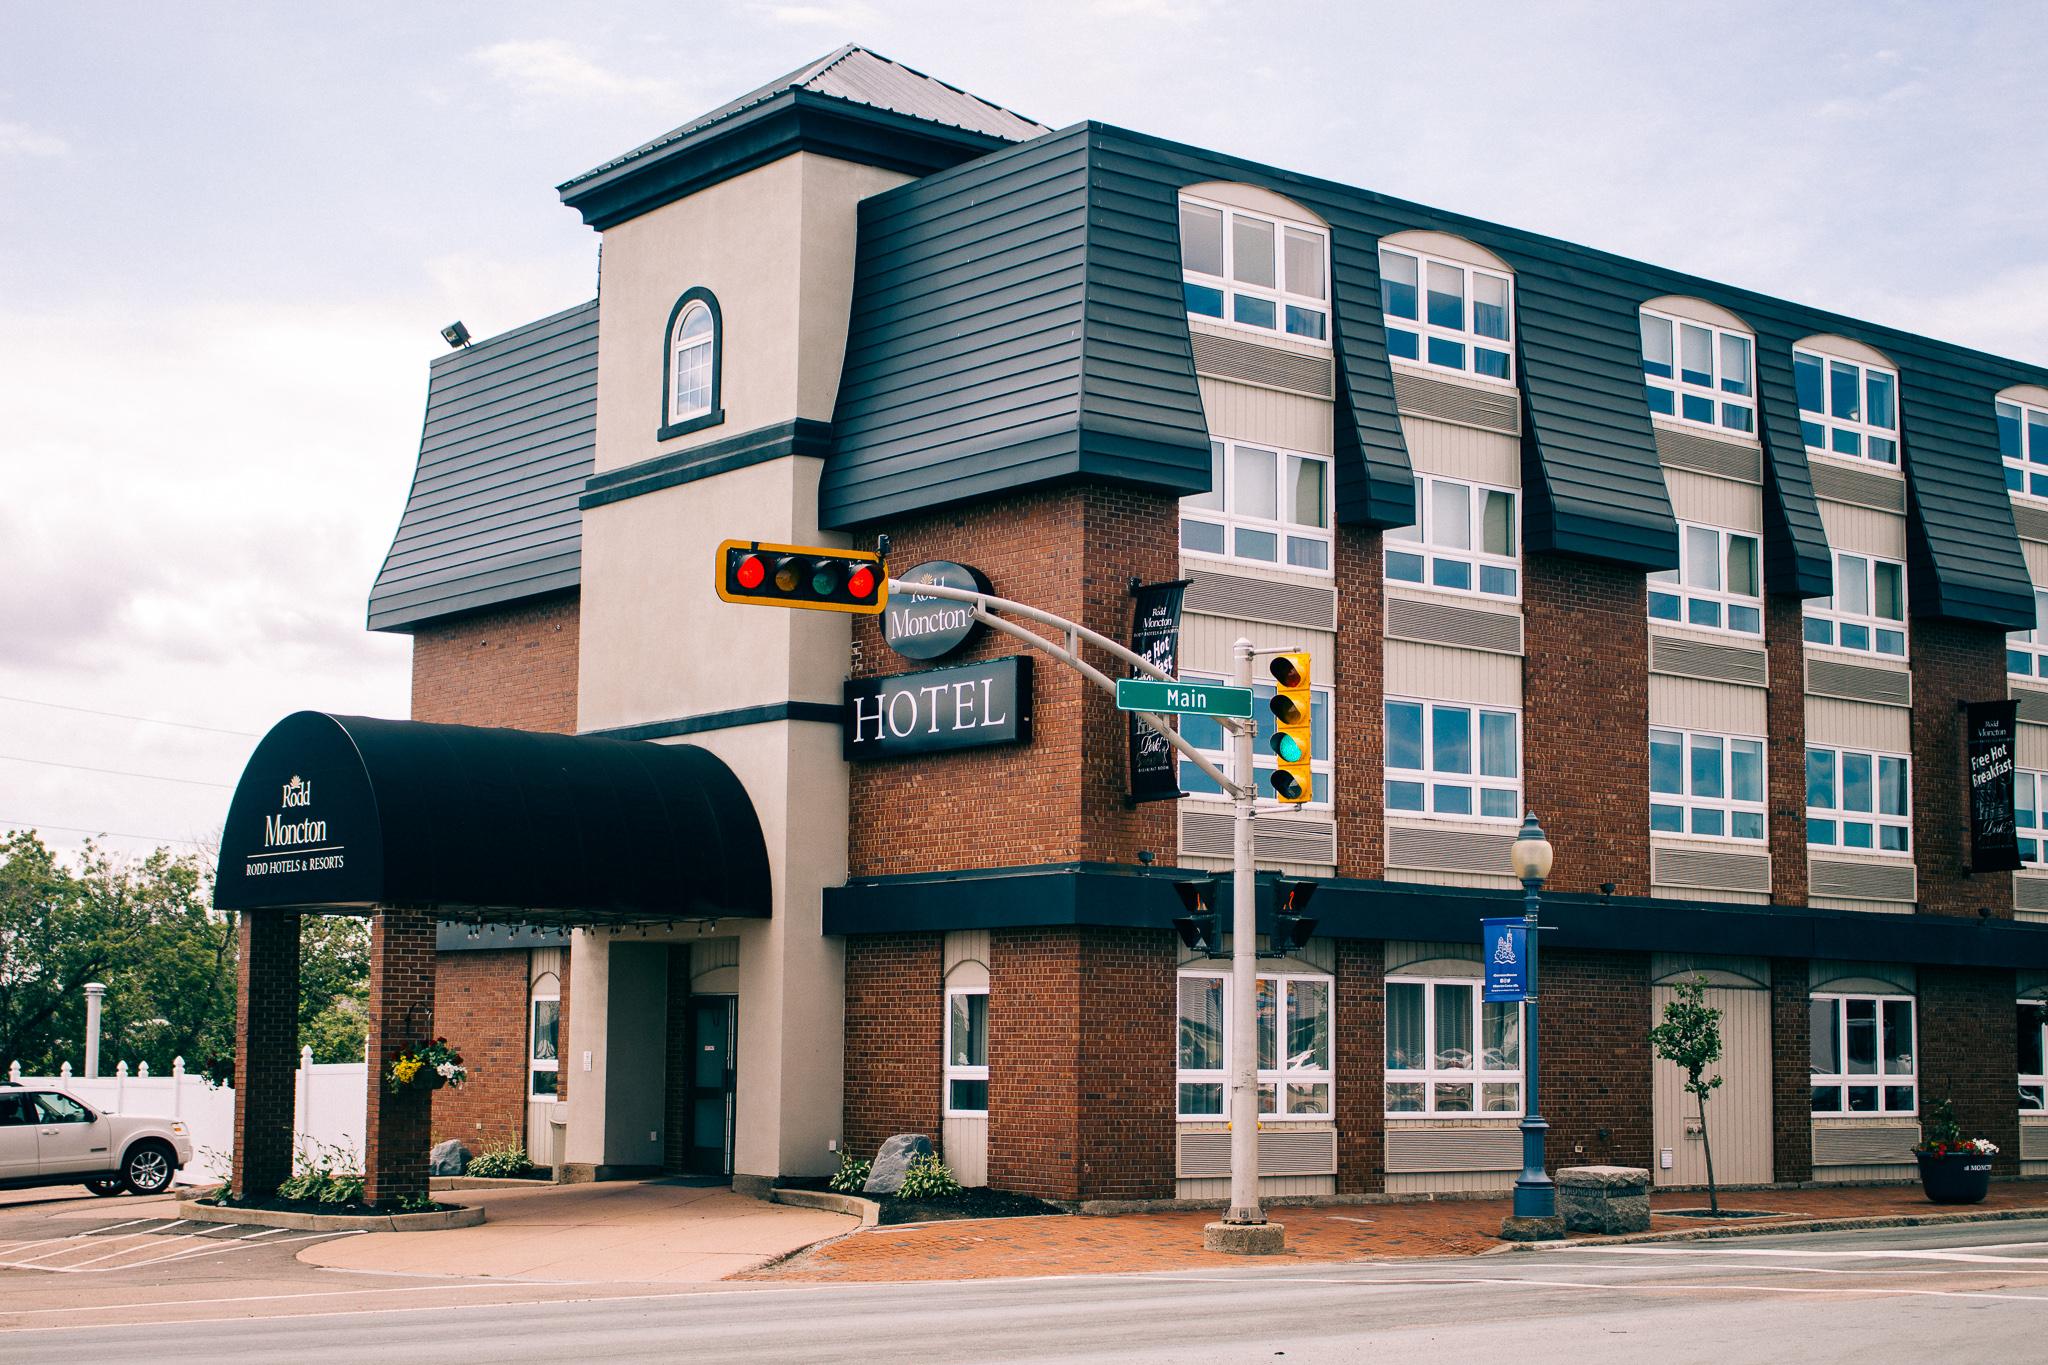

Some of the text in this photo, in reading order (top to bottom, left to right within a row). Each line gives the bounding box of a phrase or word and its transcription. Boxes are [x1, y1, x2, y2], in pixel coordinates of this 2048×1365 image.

[891, 607, 967, 640] Moncton
[1143, 617, 1172, 628] Moncton
[1152, 606, 1167, 617] Rodd
[1153, 636, 1170, 659] Hot
[853, 678, 1006, 743] HOTEL
[1167, 688, 1207, 708] Main
[1971, 743, 2007, 770] Free Hot
[1972, 758, 2013, 788] Breakfast
[282, 780, 311, 808] Rodd
[264, 814, 327, 847] Moncton
[246, 855, 344, 876] RODD HOTELS & RESORTS
